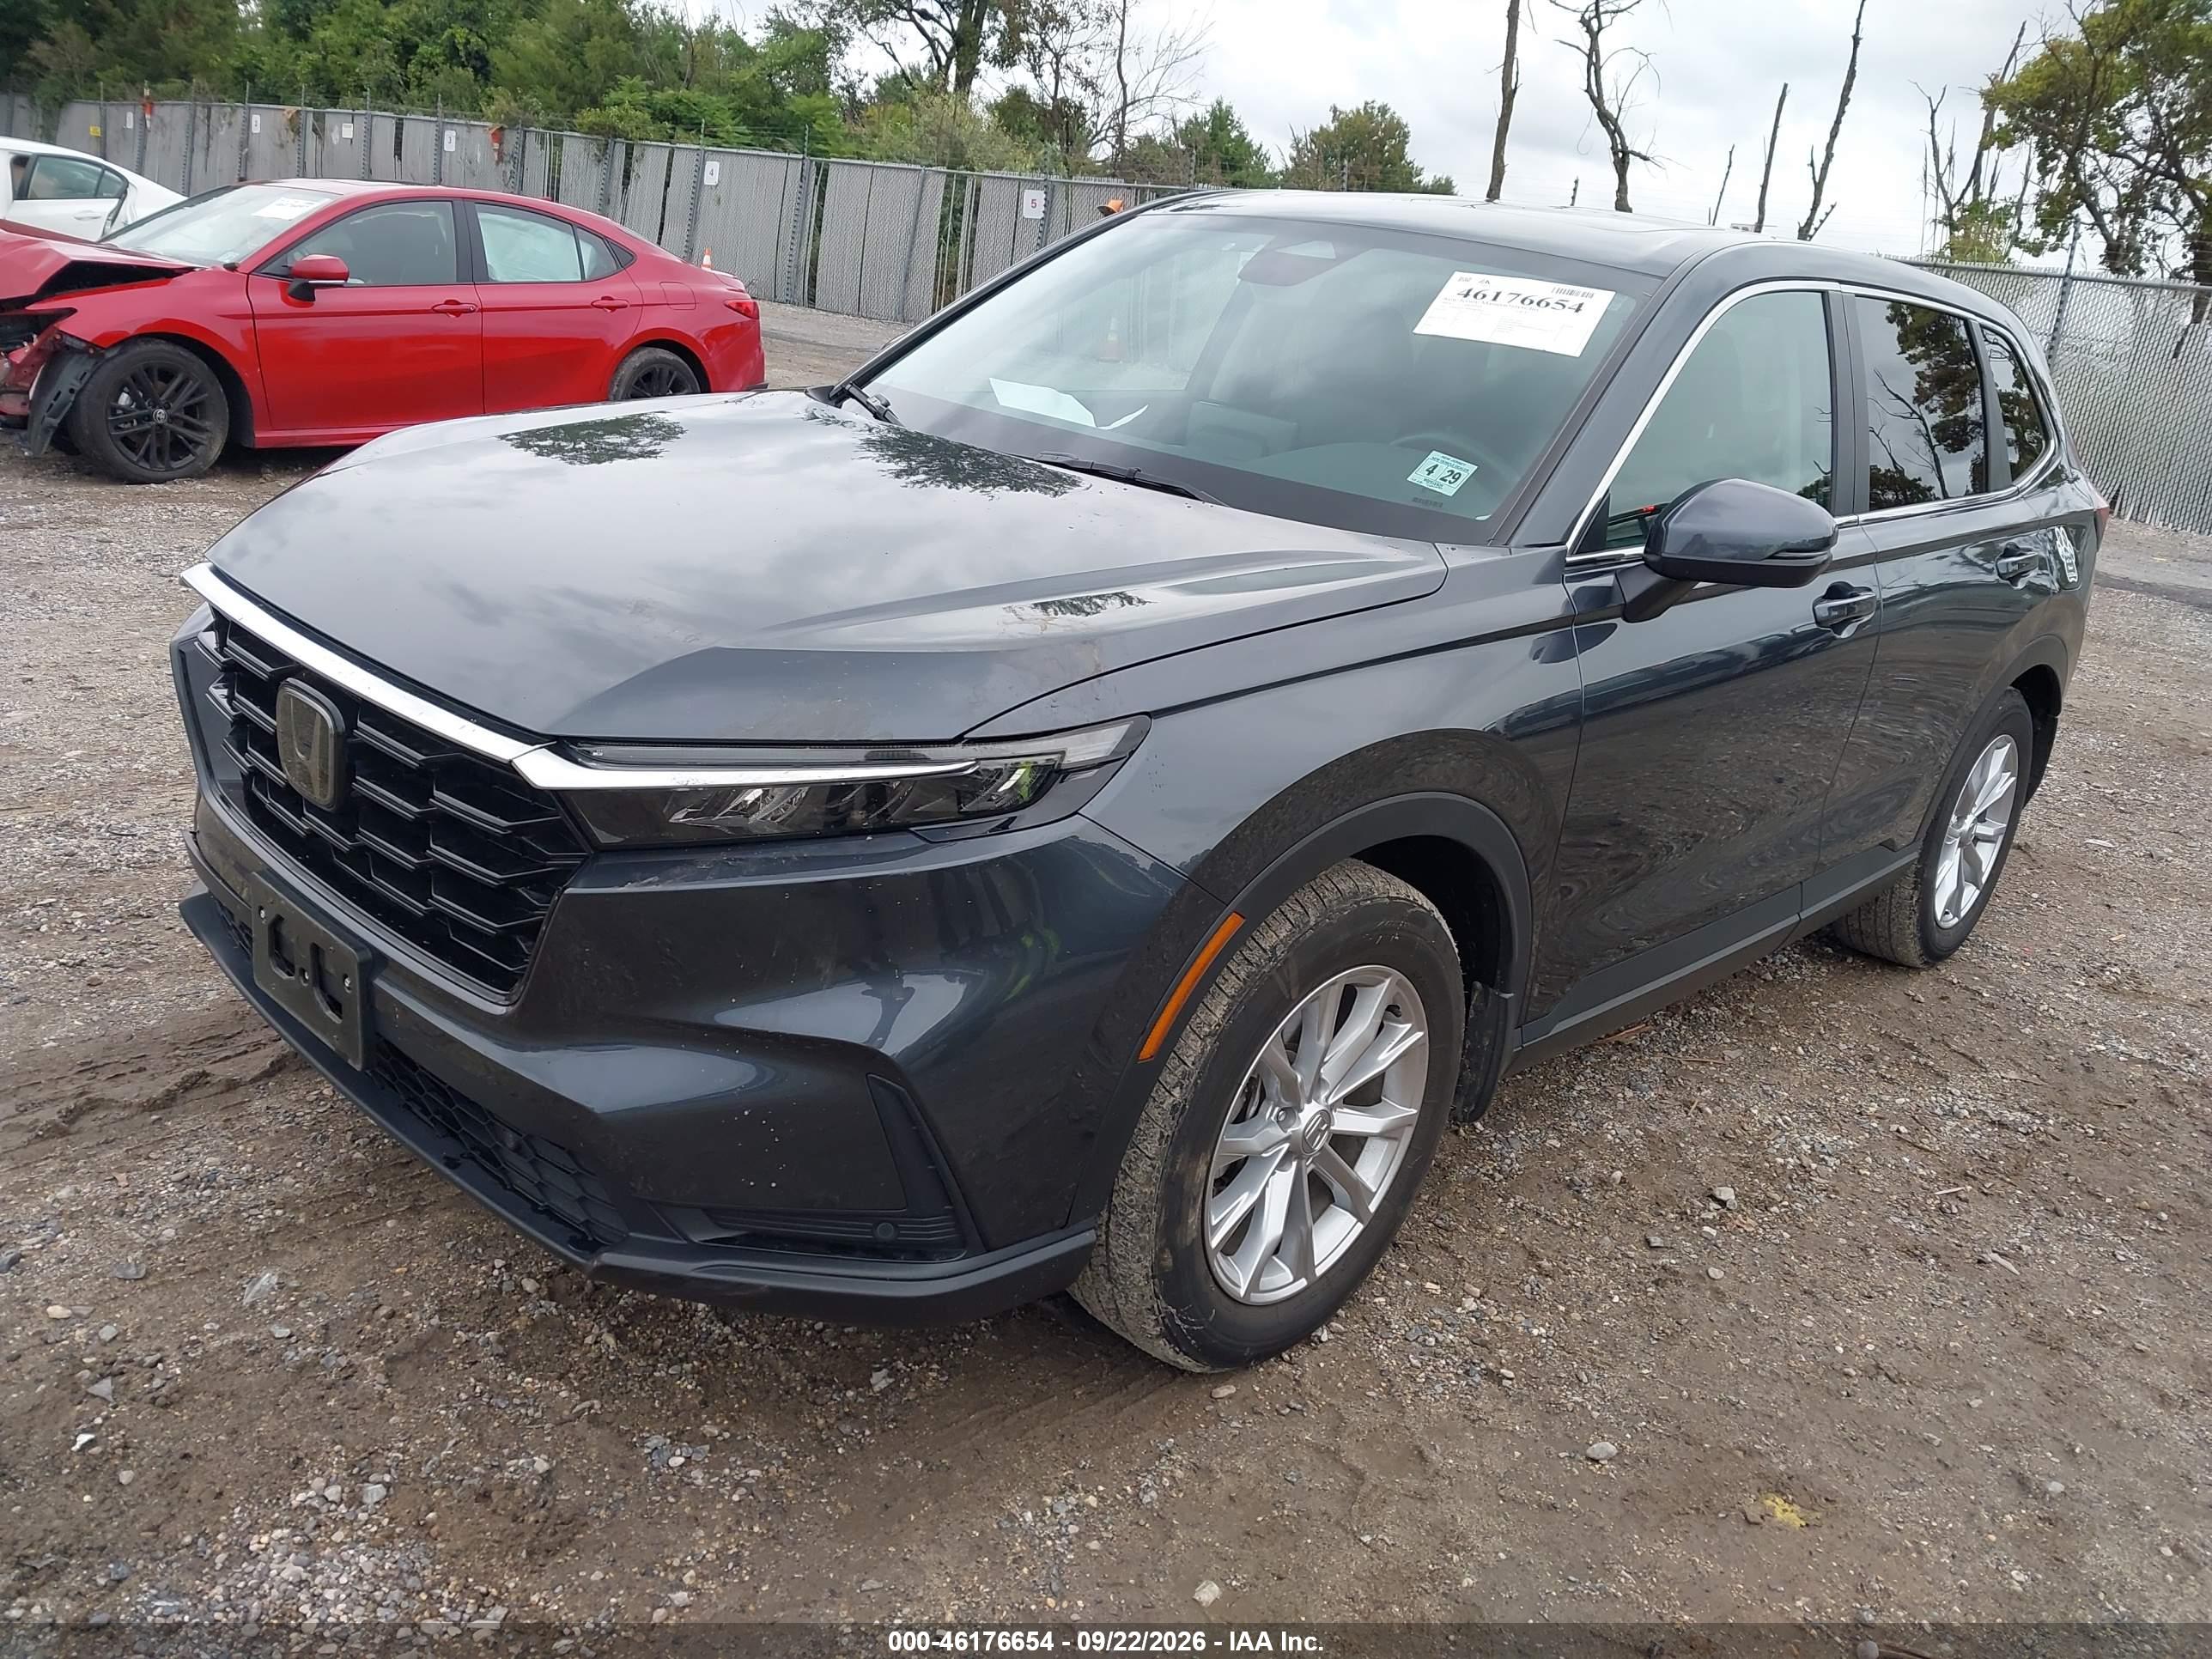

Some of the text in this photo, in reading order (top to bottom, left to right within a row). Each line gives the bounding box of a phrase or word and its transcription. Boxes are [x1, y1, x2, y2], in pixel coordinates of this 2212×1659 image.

[1030, 198, 1037, 209] 5
[1456, 287, 1585, 314] 46176654
[1425, 464, 1439, 476] 4
[1439, 470, 1462, 484] 29
